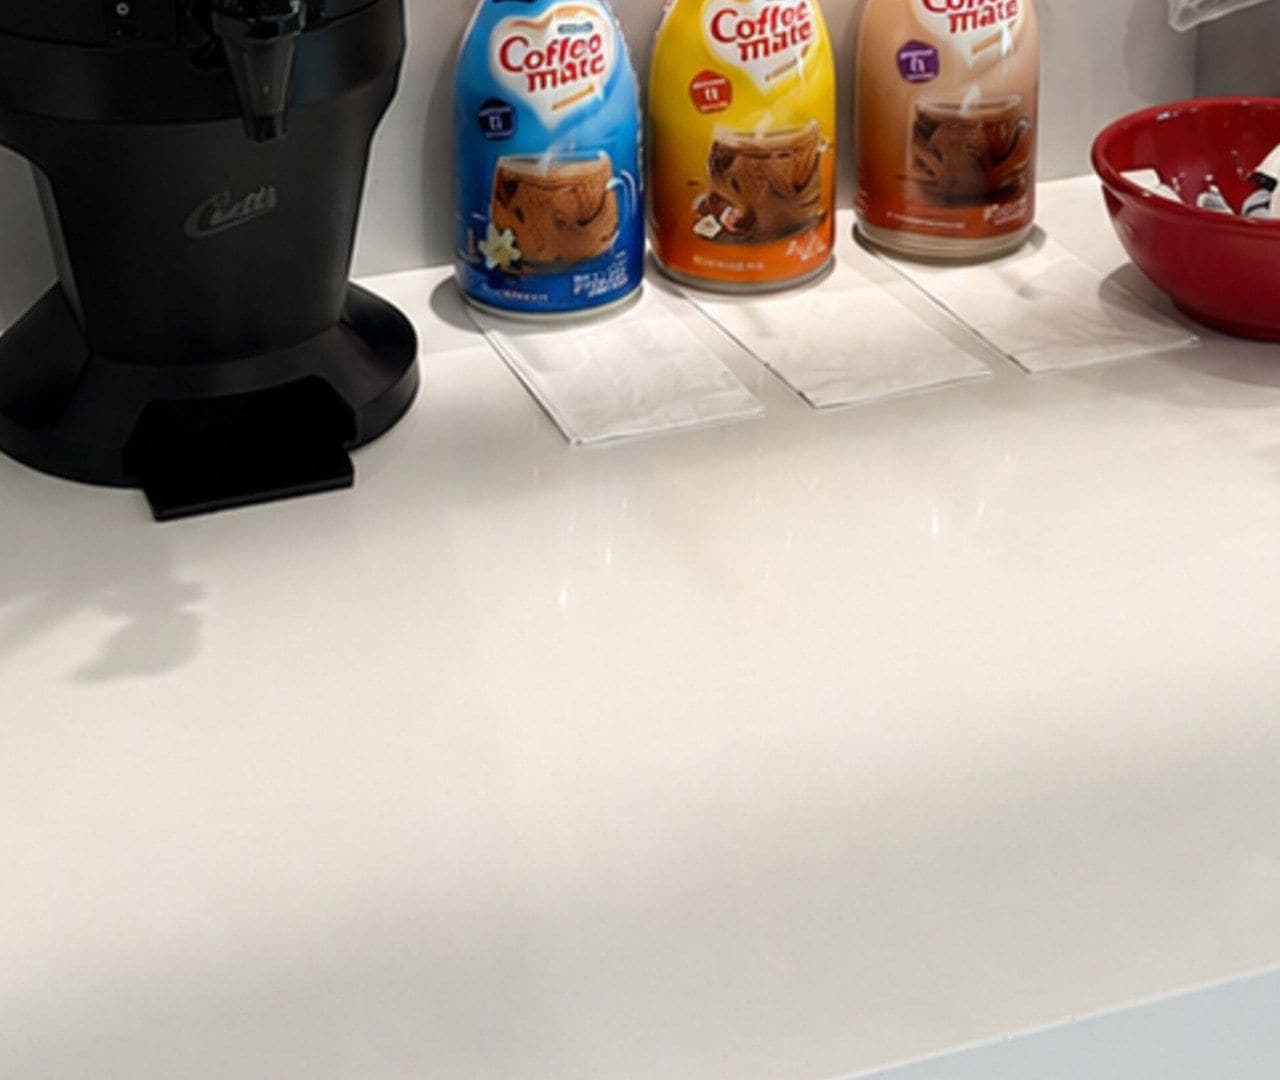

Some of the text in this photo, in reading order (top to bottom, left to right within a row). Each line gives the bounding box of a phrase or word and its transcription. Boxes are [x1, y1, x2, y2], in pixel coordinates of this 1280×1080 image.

[710, 1, 808, 44] Coffee
[738, 21, 812, 62] mate
[498, 33, 603, 74] Coffee
[525, 54, 607, 93] mate
